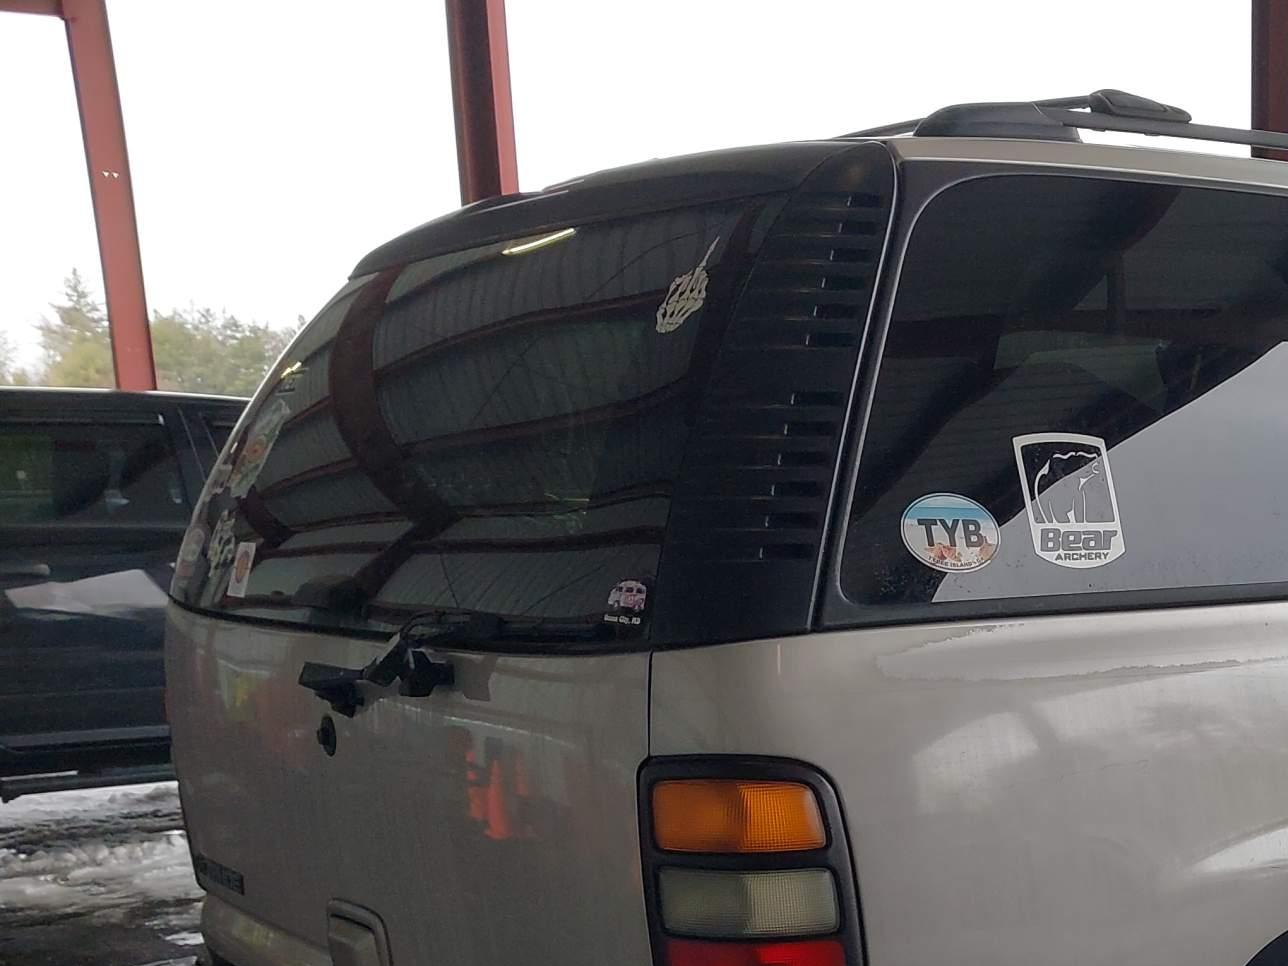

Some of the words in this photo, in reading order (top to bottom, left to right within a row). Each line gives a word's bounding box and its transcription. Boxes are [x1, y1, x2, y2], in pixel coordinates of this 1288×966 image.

[917, 518, 985, 548] TYB
[1040, 527, 1118, 552] Bear
[1055, 552, 1109, 561] ARCHERY
